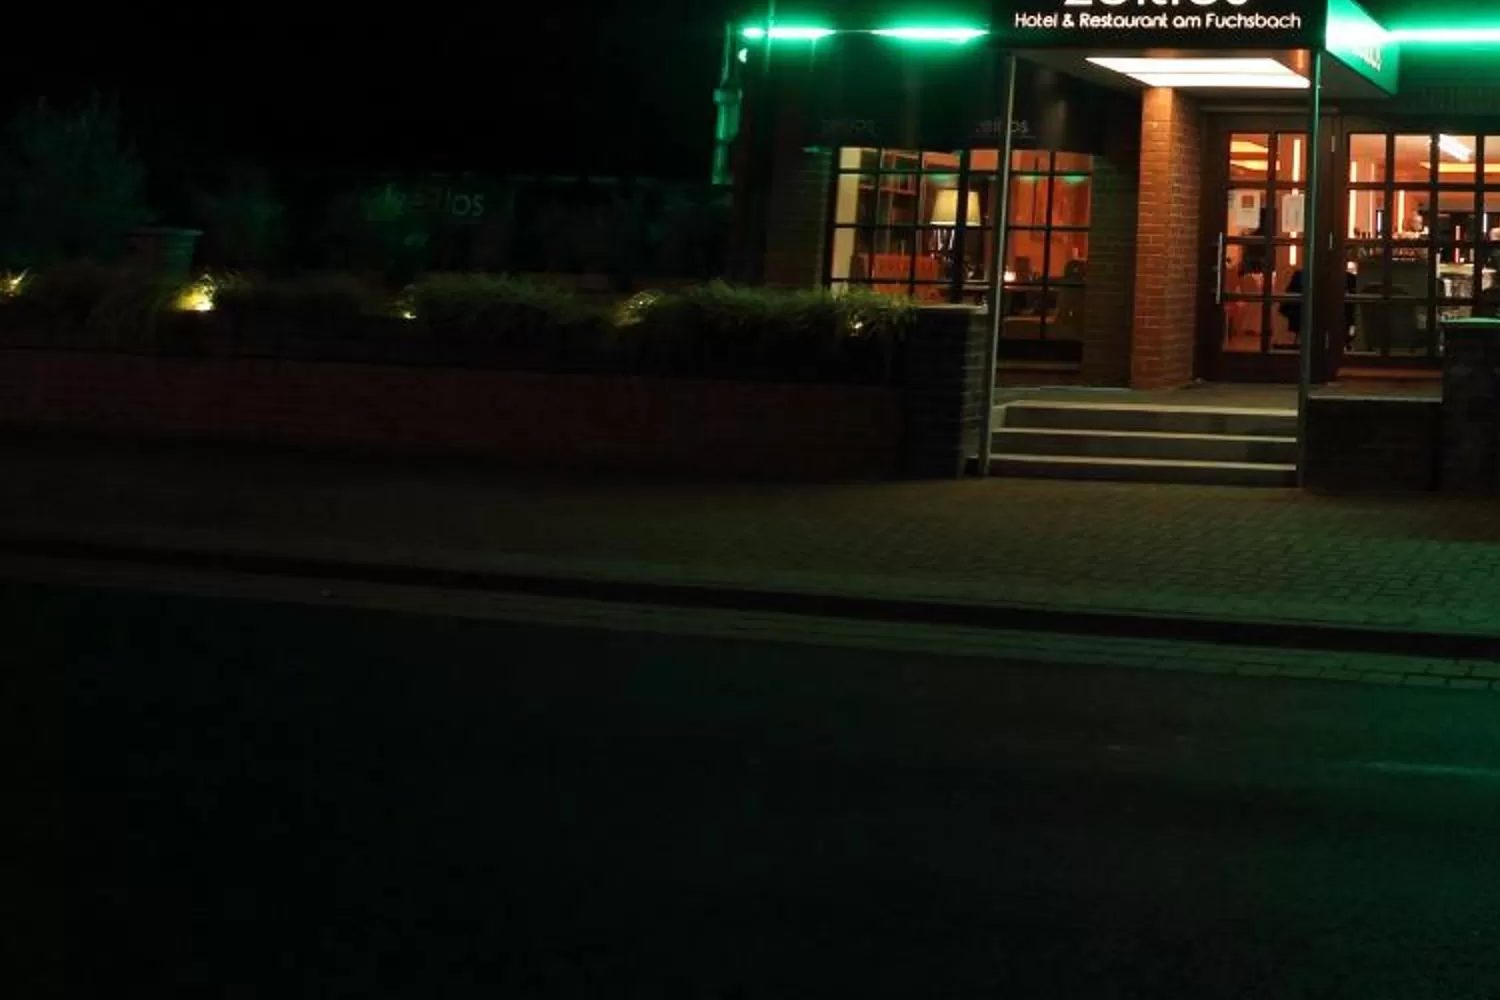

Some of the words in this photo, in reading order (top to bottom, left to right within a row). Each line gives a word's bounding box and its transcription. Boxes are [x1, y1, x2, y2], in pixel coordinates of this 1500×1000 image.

[1014, 12, 1057, 28] Hotel
[1062, 13, 1074, 27] &
[1079, 12, 1168, 28] Restaurant
[1173, 15, 1200, 28] am
[1205, 12, 1301, 29] Fuchsbach
